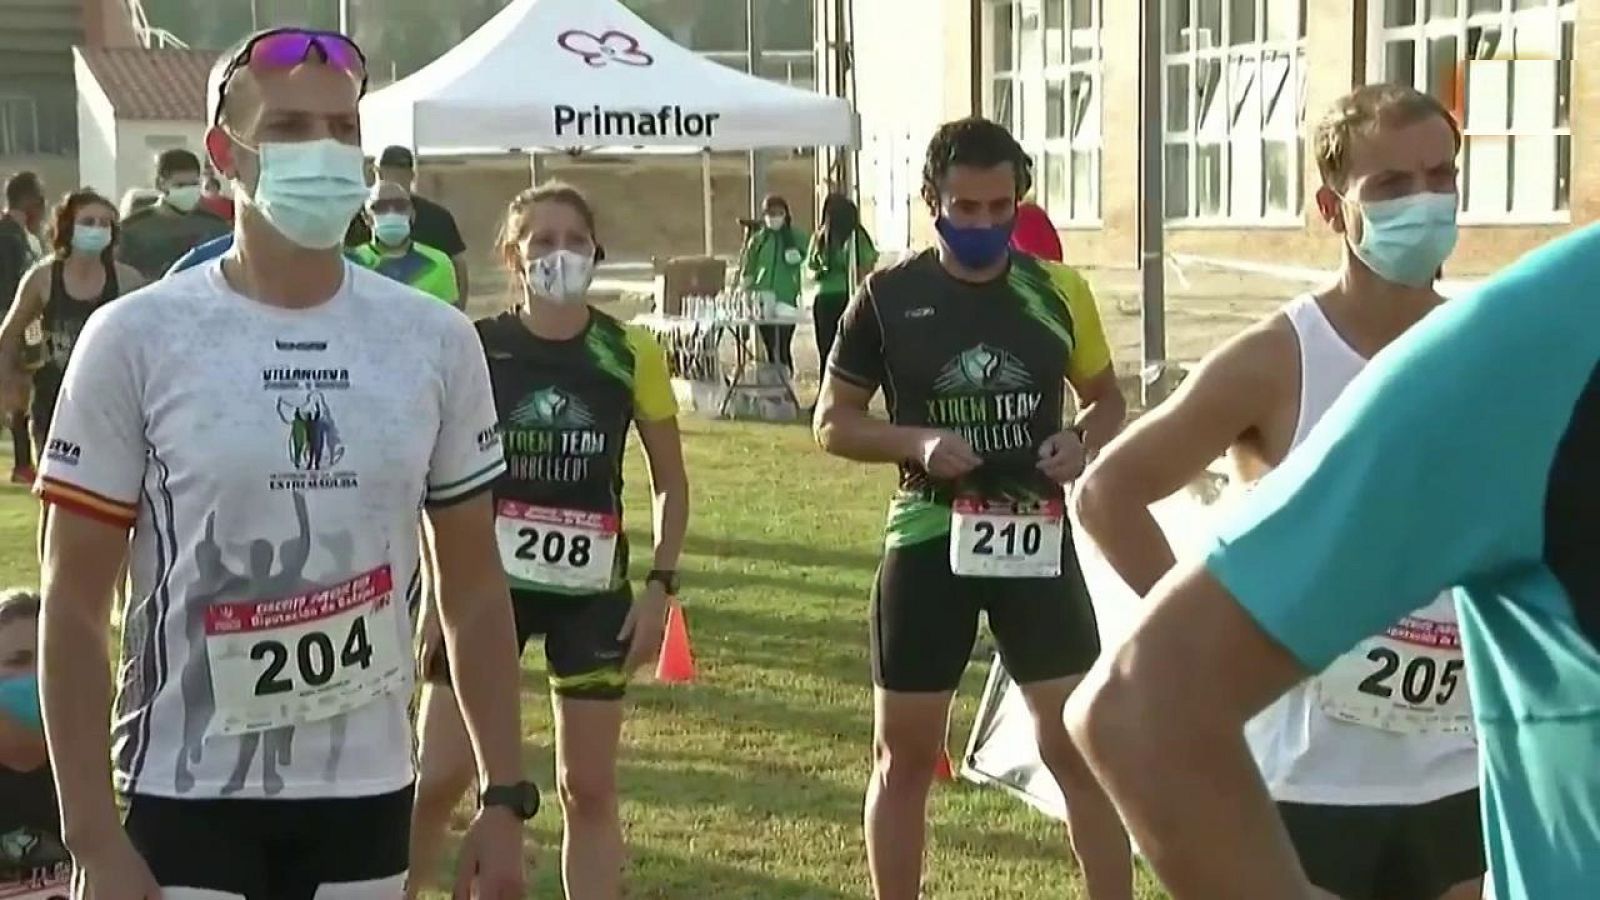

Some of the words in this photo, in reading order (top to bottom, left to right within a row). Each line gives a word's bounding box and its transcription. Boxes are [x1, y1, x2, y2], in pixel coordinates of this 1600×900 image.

[554, 104, 720, 137] Primaflor
[561, 430, 606, 454] TEAM
[514, 527, 592, 567] 208
[972, 521, 1042, 556] 210
[250, 615, 373, 697] 204
[1358, 646, 1465, 706] 205
